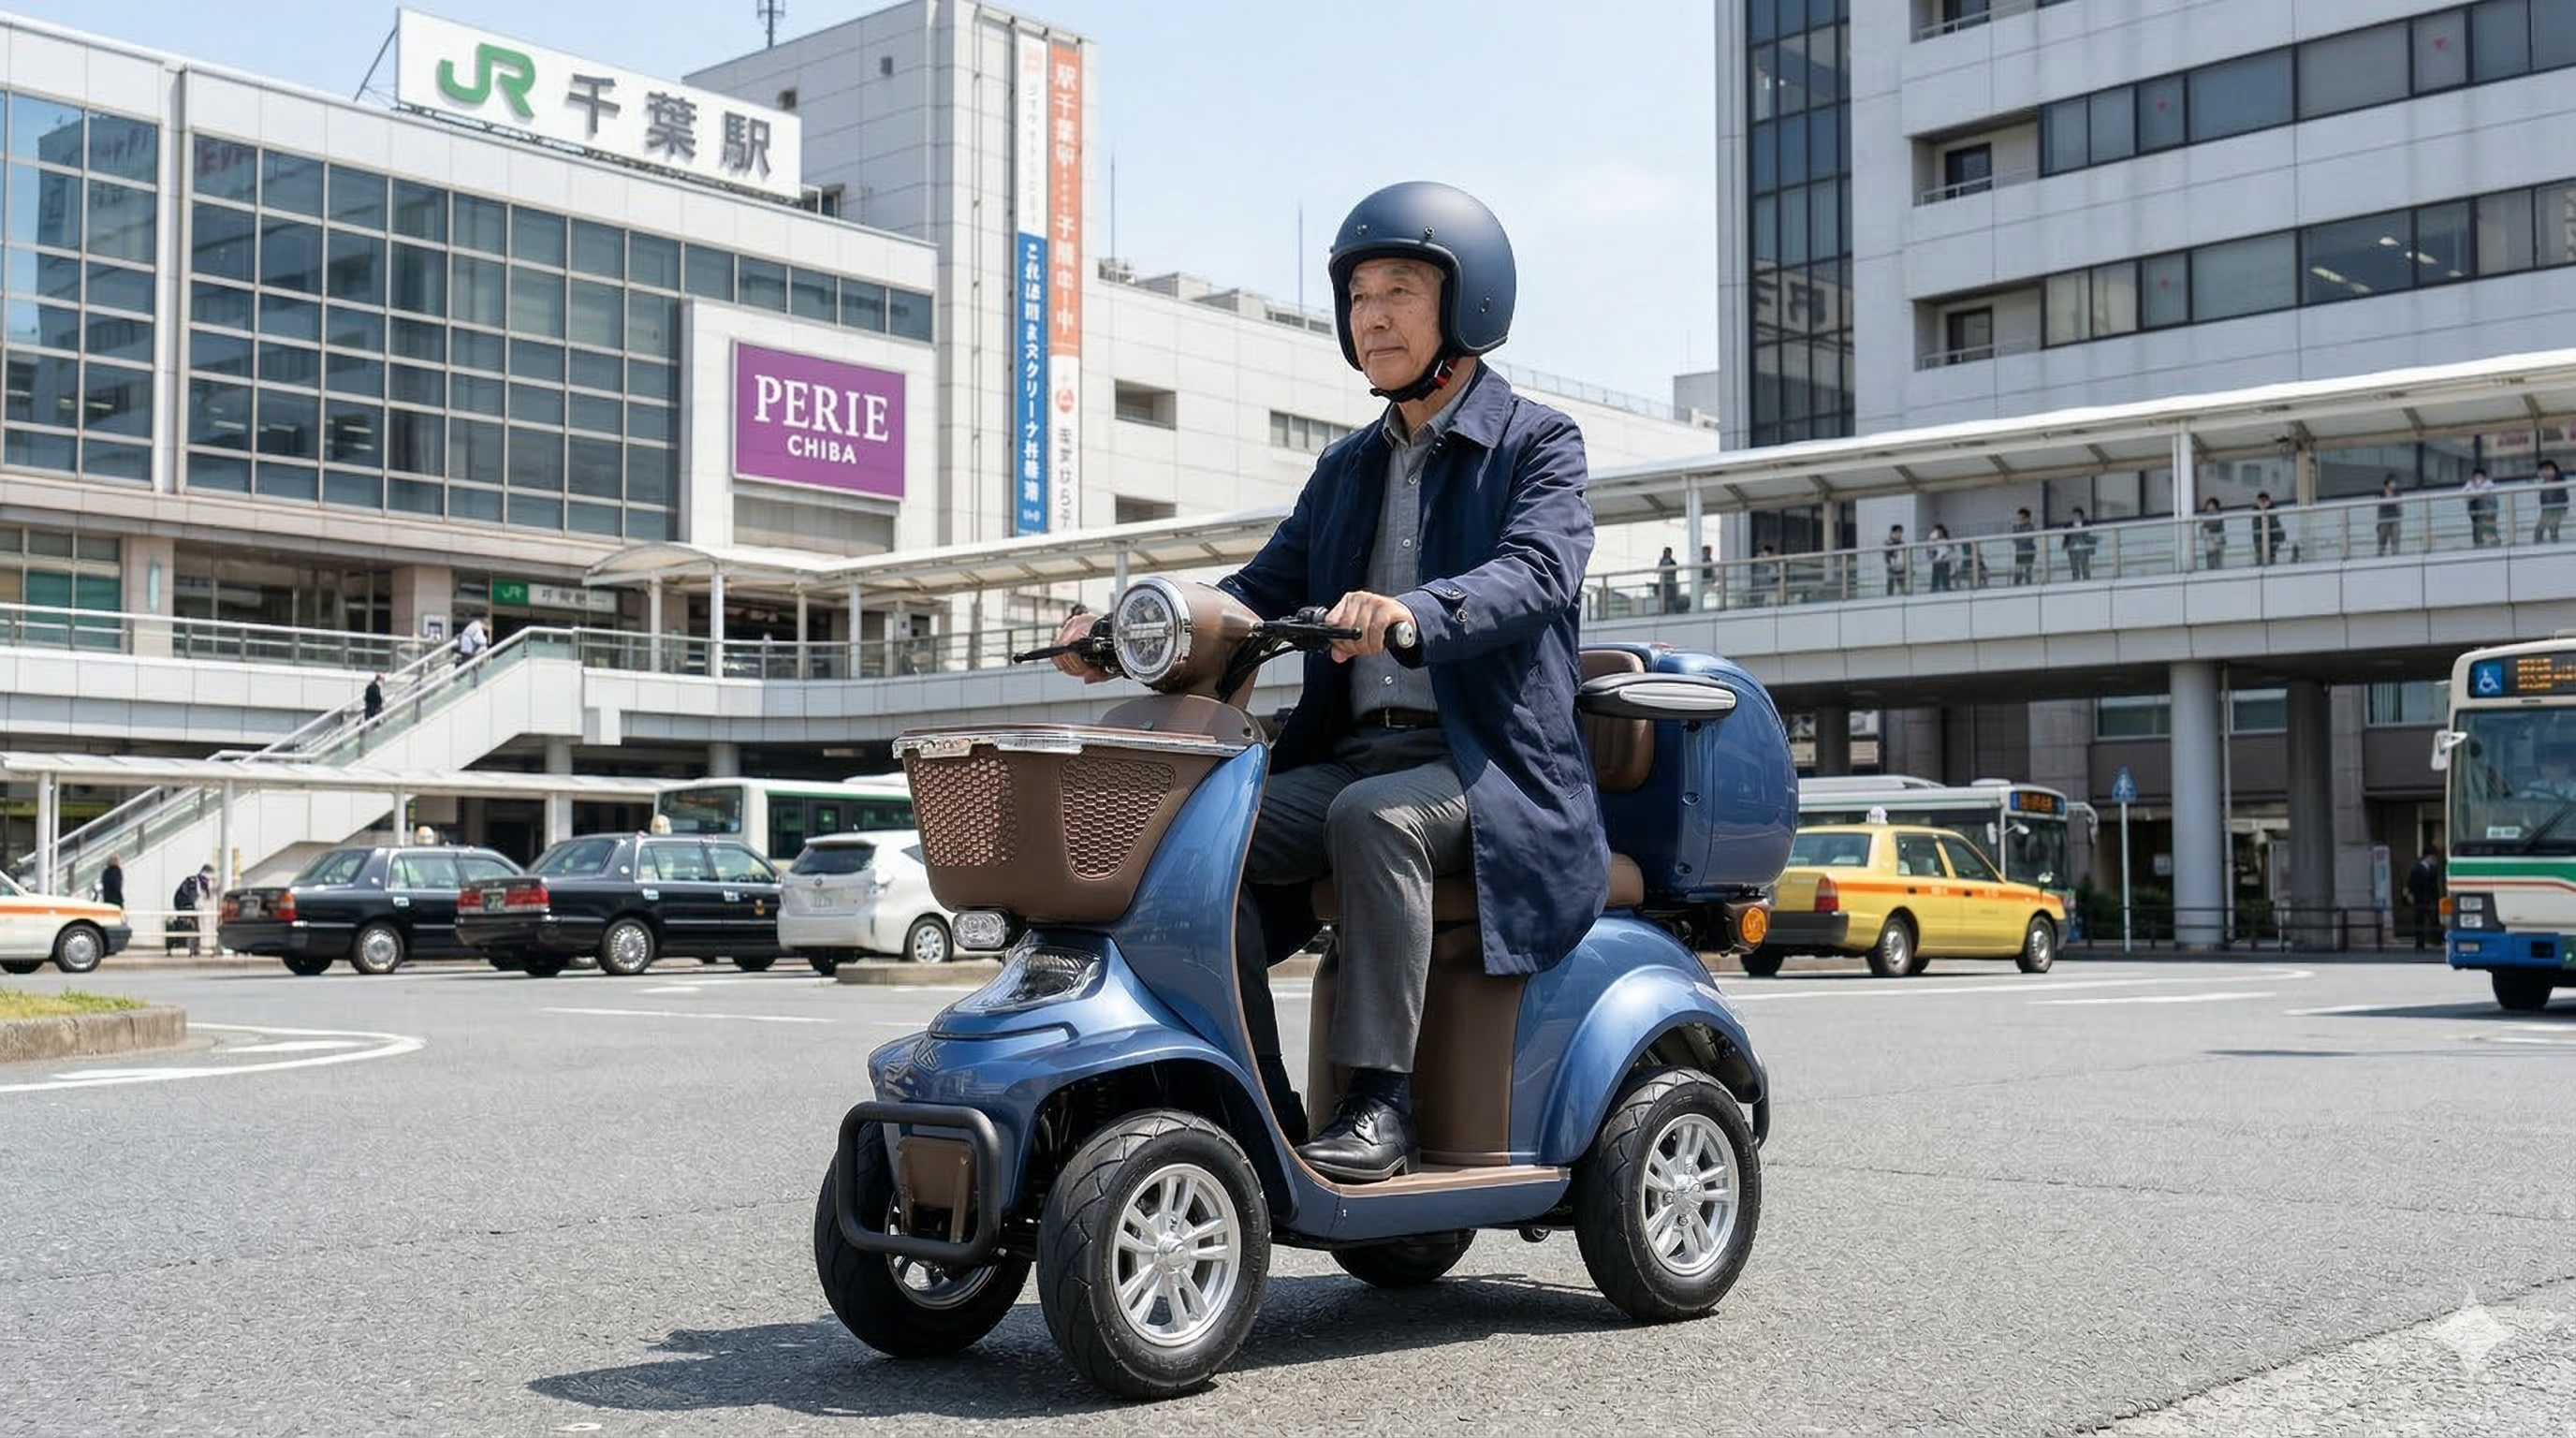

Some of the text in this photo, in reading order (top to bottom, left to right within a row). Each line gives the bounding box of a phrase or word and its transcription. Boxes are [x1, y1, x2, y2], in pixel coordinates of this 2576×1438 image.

[438, 42, 771, 175] JR 千葉駅
[754, 374, 889, 443] PERIE
[787, 434, 857, 464] CHIBA
[502, 585, 524, 599] JR
